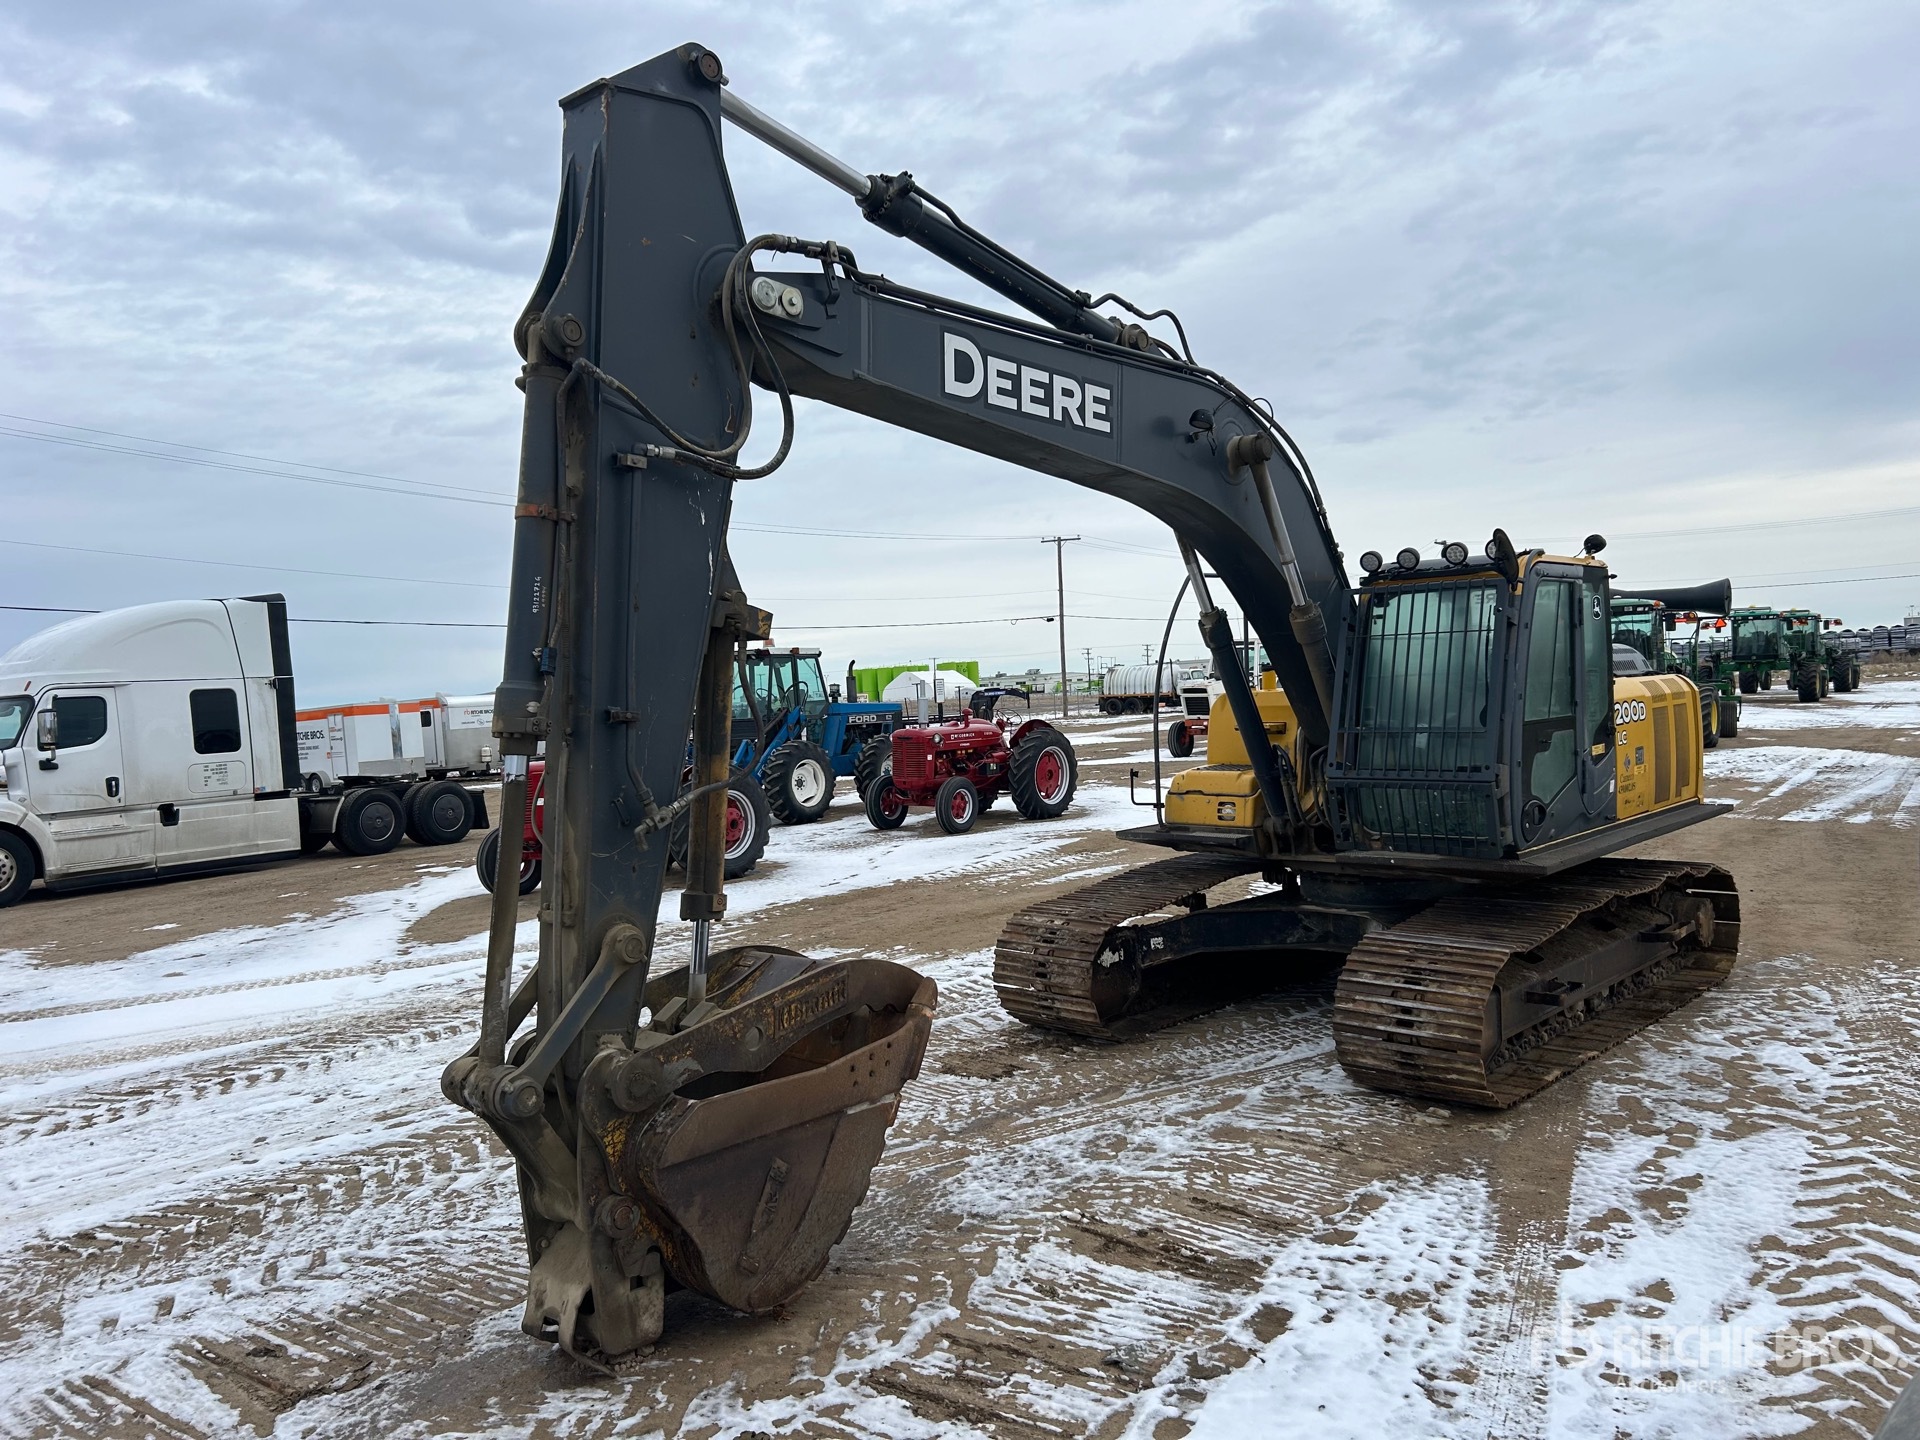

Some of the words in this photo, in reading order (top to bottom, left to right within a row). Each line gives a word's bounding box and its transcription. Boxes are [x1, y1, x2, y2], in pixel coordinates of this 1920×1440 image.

[943, 331, 1111, 433] DEERE
[848, 715, 877, 724] FORD
[1613, 700, 1646, 725] 200D
[310, 730, 325, 740] BROS.
[1617, 731, 1627, 745] LC
